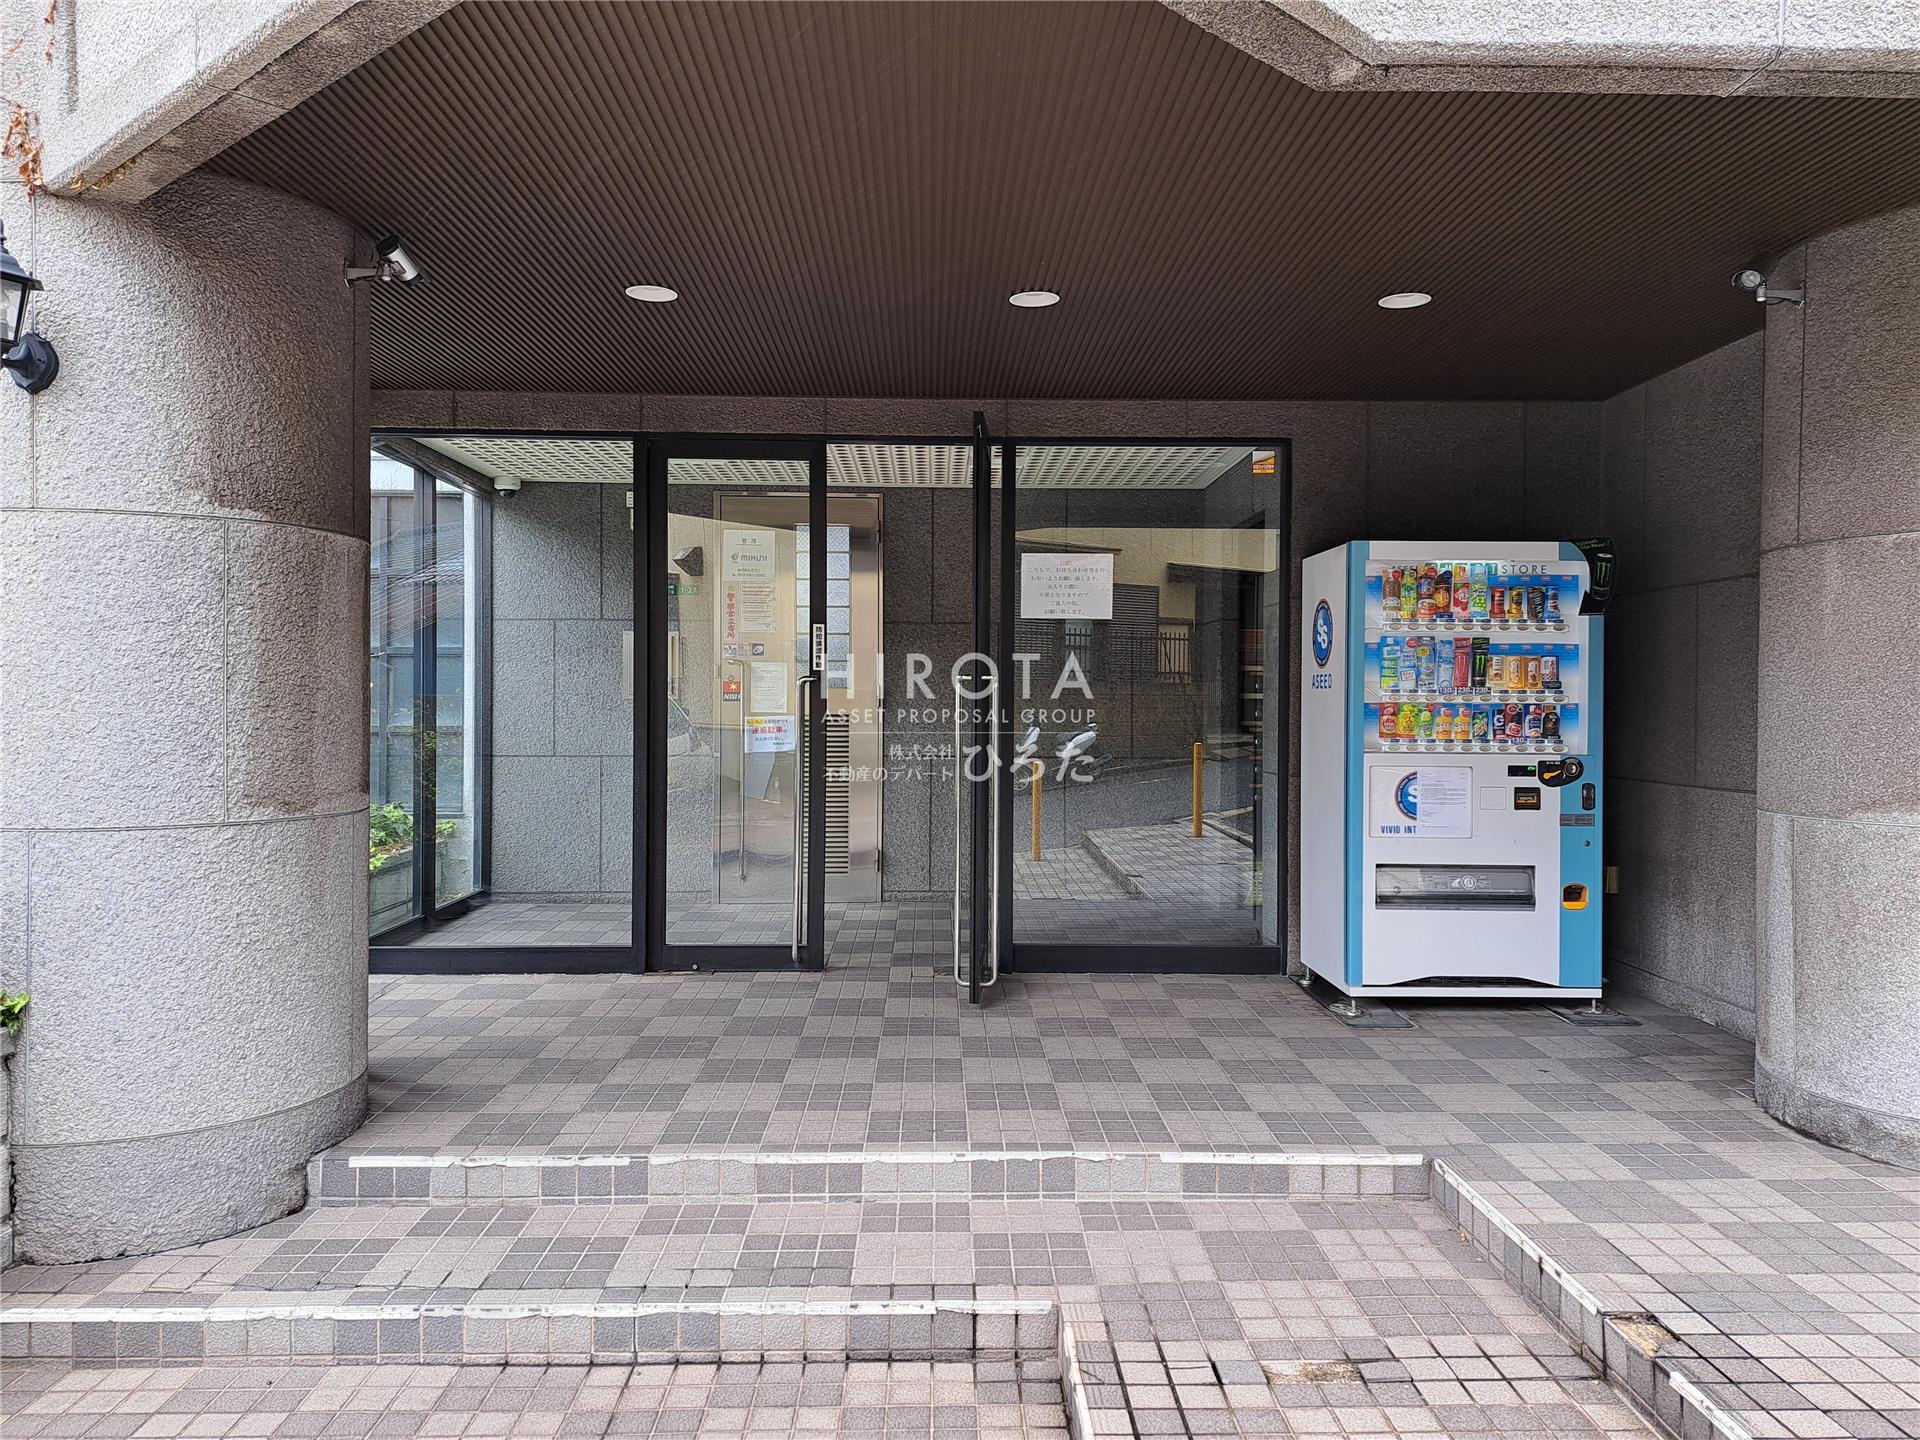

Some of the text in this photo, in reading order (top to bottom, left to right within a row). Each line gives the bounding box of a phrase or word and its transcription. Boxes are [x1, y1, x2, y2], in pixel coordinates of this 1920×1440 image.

[1501, 564, 1547, 574] STORE
[1312, 673, 1333, 690] ASEED
[1380, 825, 1401, 834] VIVID
